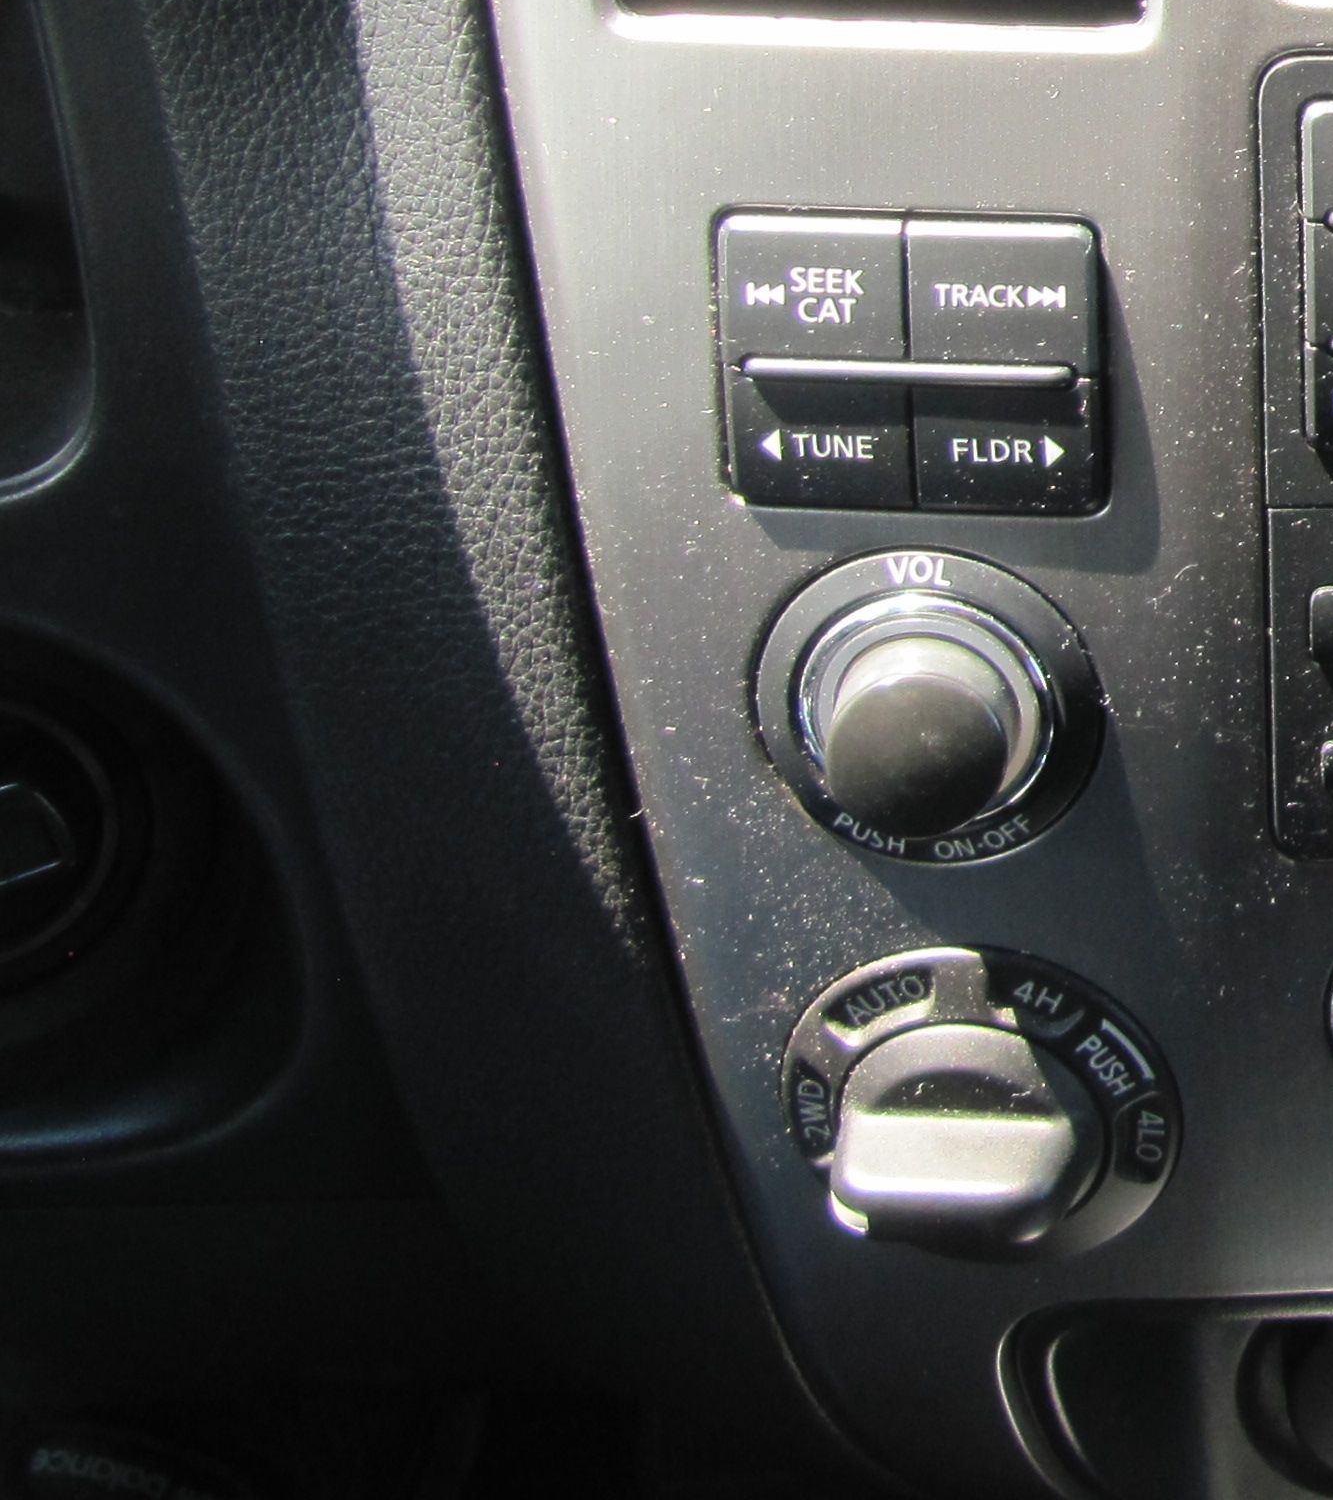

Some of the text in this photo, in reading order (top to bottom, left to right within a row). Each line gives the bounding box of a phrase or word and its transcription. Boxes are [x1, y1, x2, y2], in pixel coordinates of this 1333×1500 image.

[789, 266, 864, 296] SEEK
[934, 282, 1025, 308] TRACK
[798, 297, 857, 324] CAT
[793, 433, 875, 461] TUNE
[951, 438, 1034, 465] FLDR
[886, 554, 953, 587] VOL
[833, 811, 906, 854] PUSH
[845, 975, 926, 1026] AUTO
[1013, 980, 1064, 1014] 4H
[1075, 1033, 1136, 1099] PUSH
[797, 1079, 831, 1142] 2WD
[1136, 1109, 1166, 1163] 4LO
